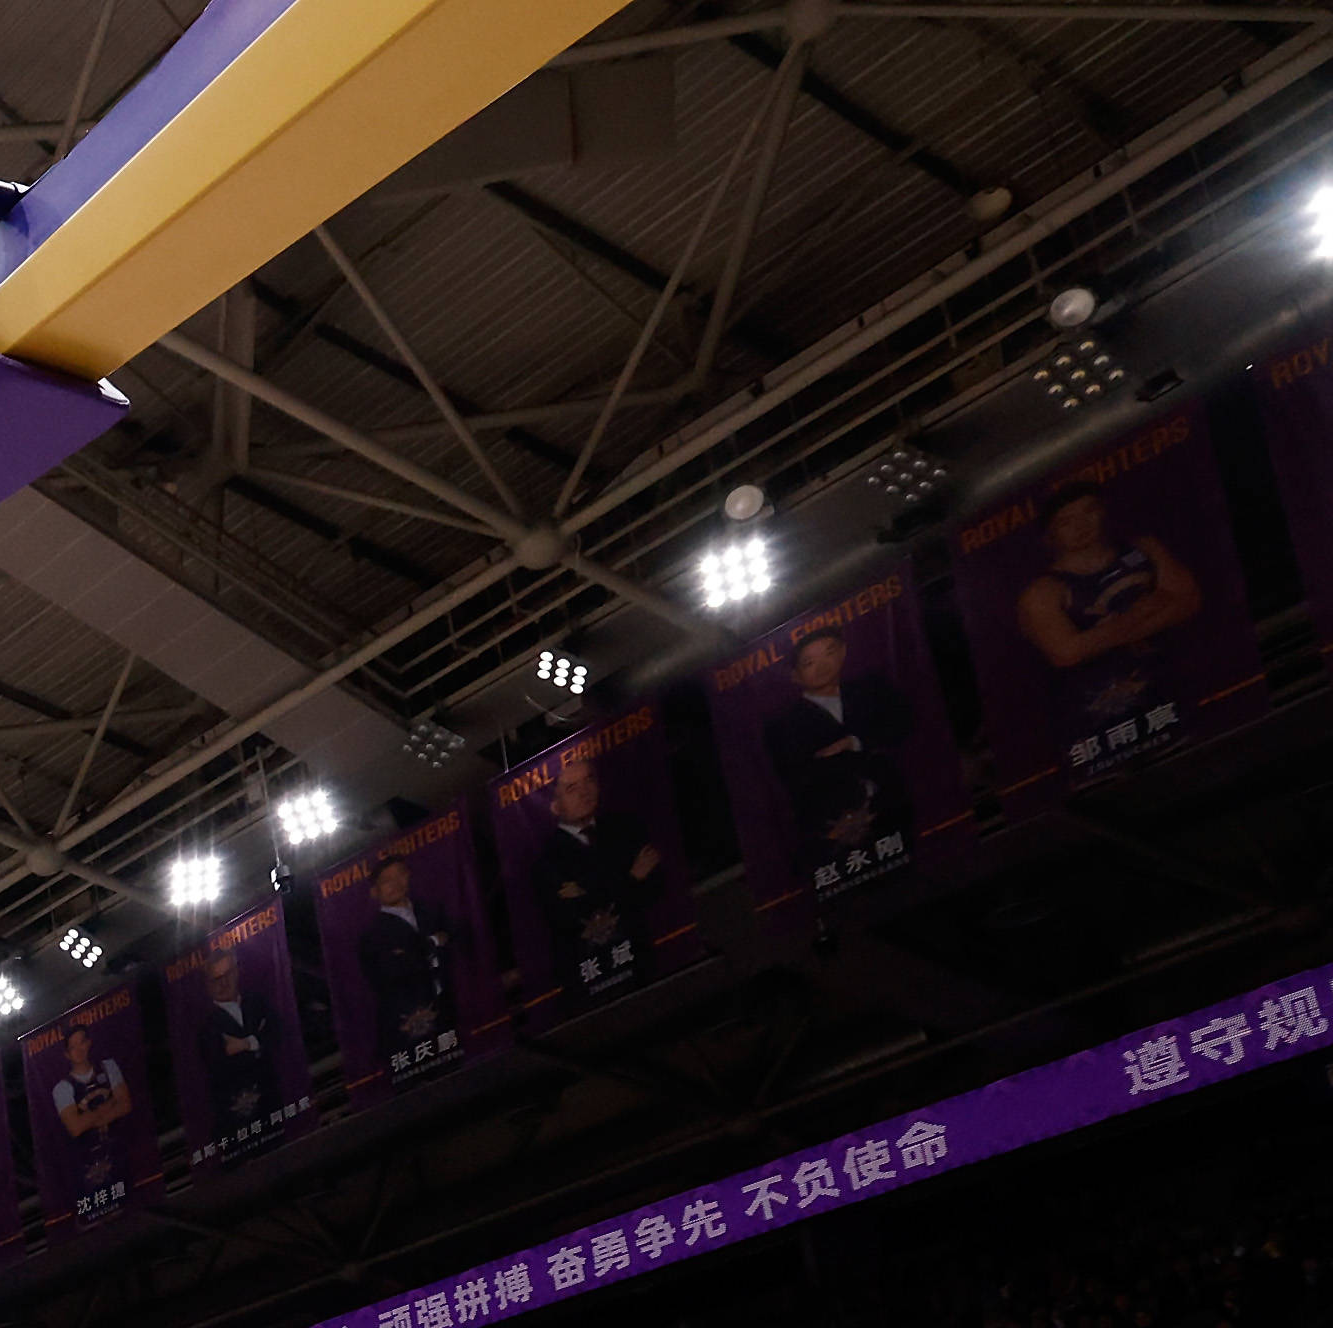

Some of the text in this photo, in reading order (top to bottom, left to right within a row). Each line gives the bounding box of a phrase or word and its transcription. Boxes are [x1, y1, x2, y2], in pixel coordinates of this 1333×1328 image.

[814, 831, 905, 890] 赵永刚
[390, 1029, 461, 1073] 张庆鹏
[1123, 981, 1333, 1096] 遵守规
[546, 1199, 727, 1292] 奋勇争先
[740, 1120, 949, 1222] 不负使命
